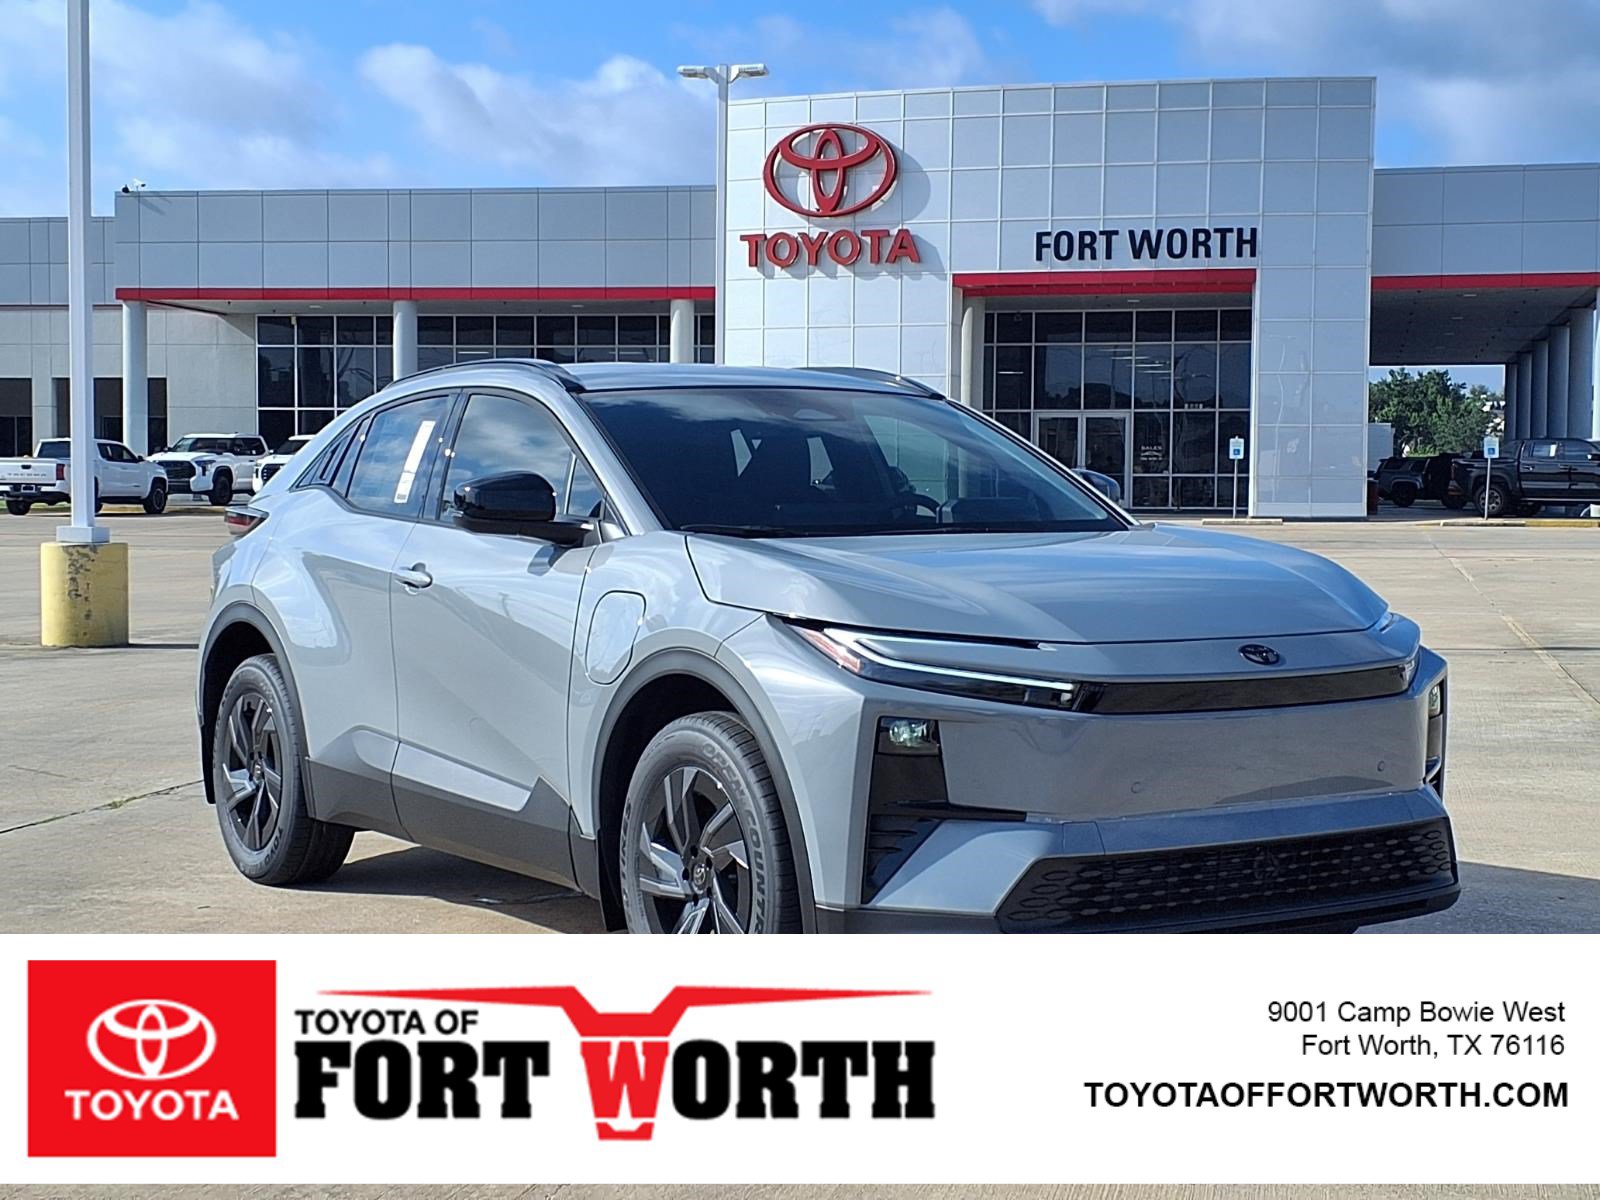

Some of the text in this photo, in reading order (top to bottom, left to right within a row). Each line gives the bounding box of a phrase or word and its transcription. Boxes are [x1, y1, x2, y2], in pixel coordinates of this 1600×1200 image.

[740, 229, 920, 268] TOYOTA
[1036, 227, 1257, 262] FORT WORTH
